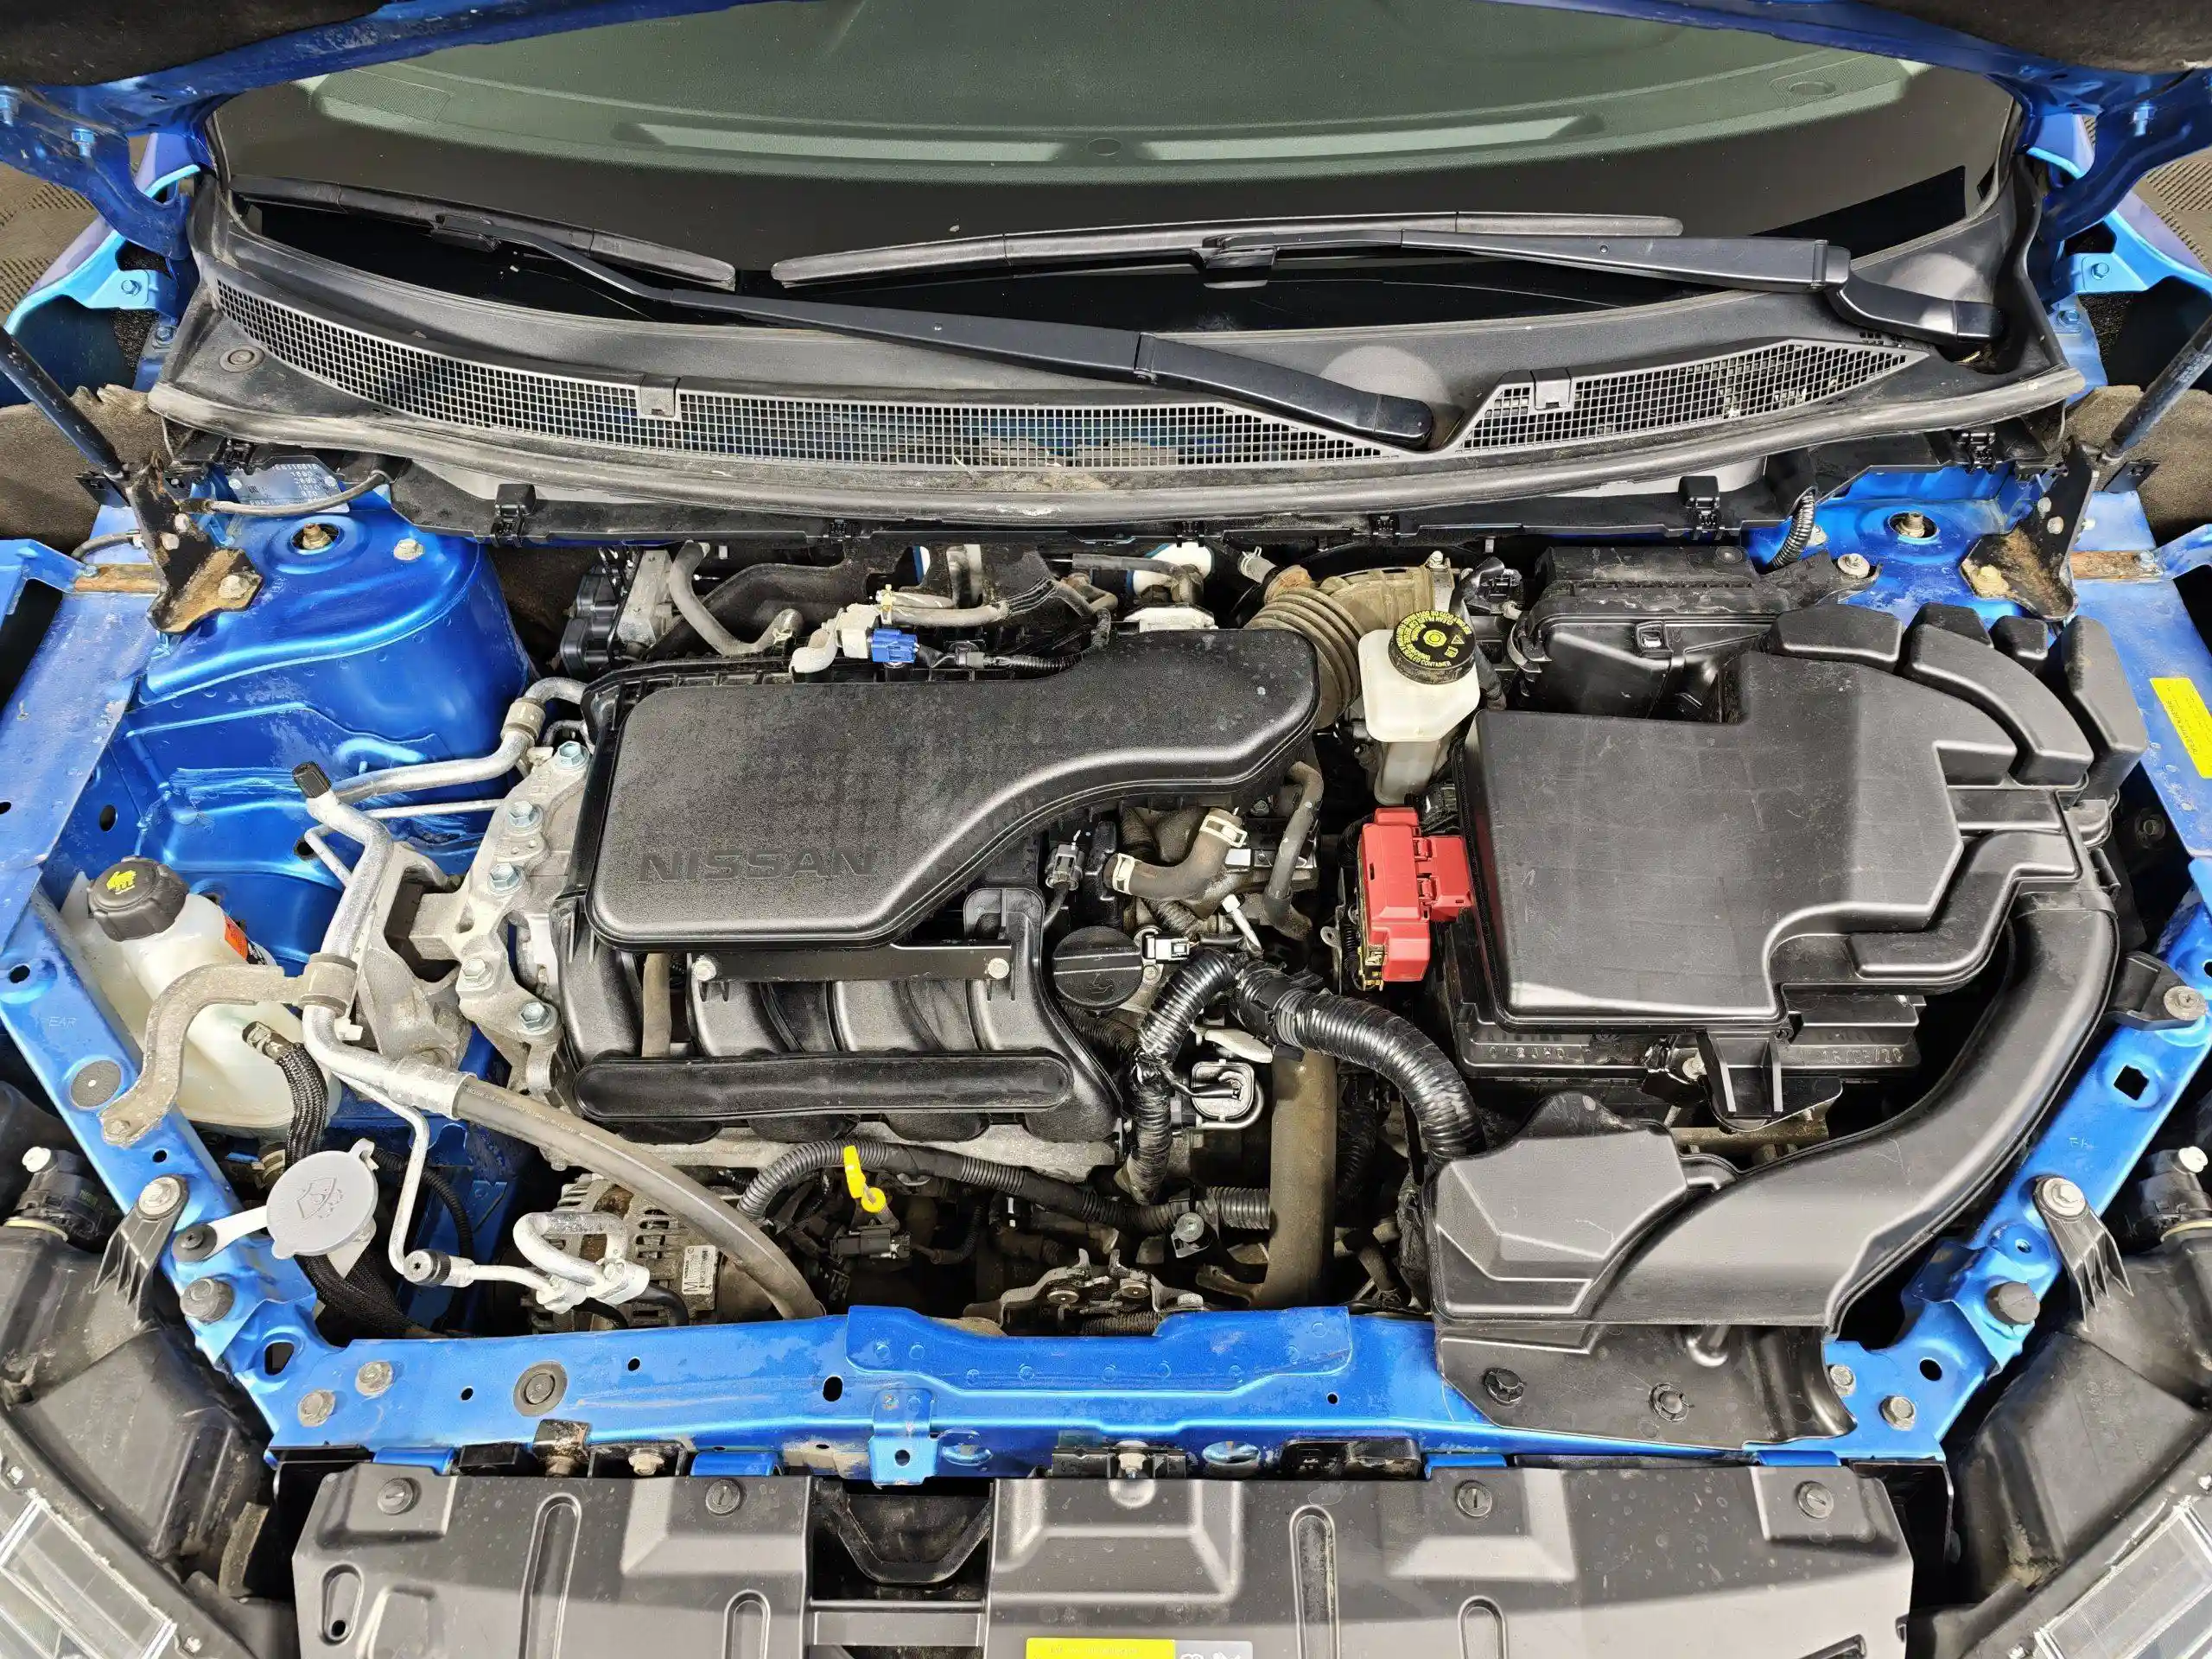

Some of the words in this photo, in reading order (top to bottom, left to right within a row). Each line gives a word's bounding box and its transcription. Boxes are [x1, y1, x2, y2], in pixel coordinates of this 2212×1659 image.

[1435, 616, 1453, 626] CLEAN
[1402, 650, 1421, 663] SEALED
[1407, 644, 1431, 661] REMOVING
[638, 846, 876, 883] NISSAN
